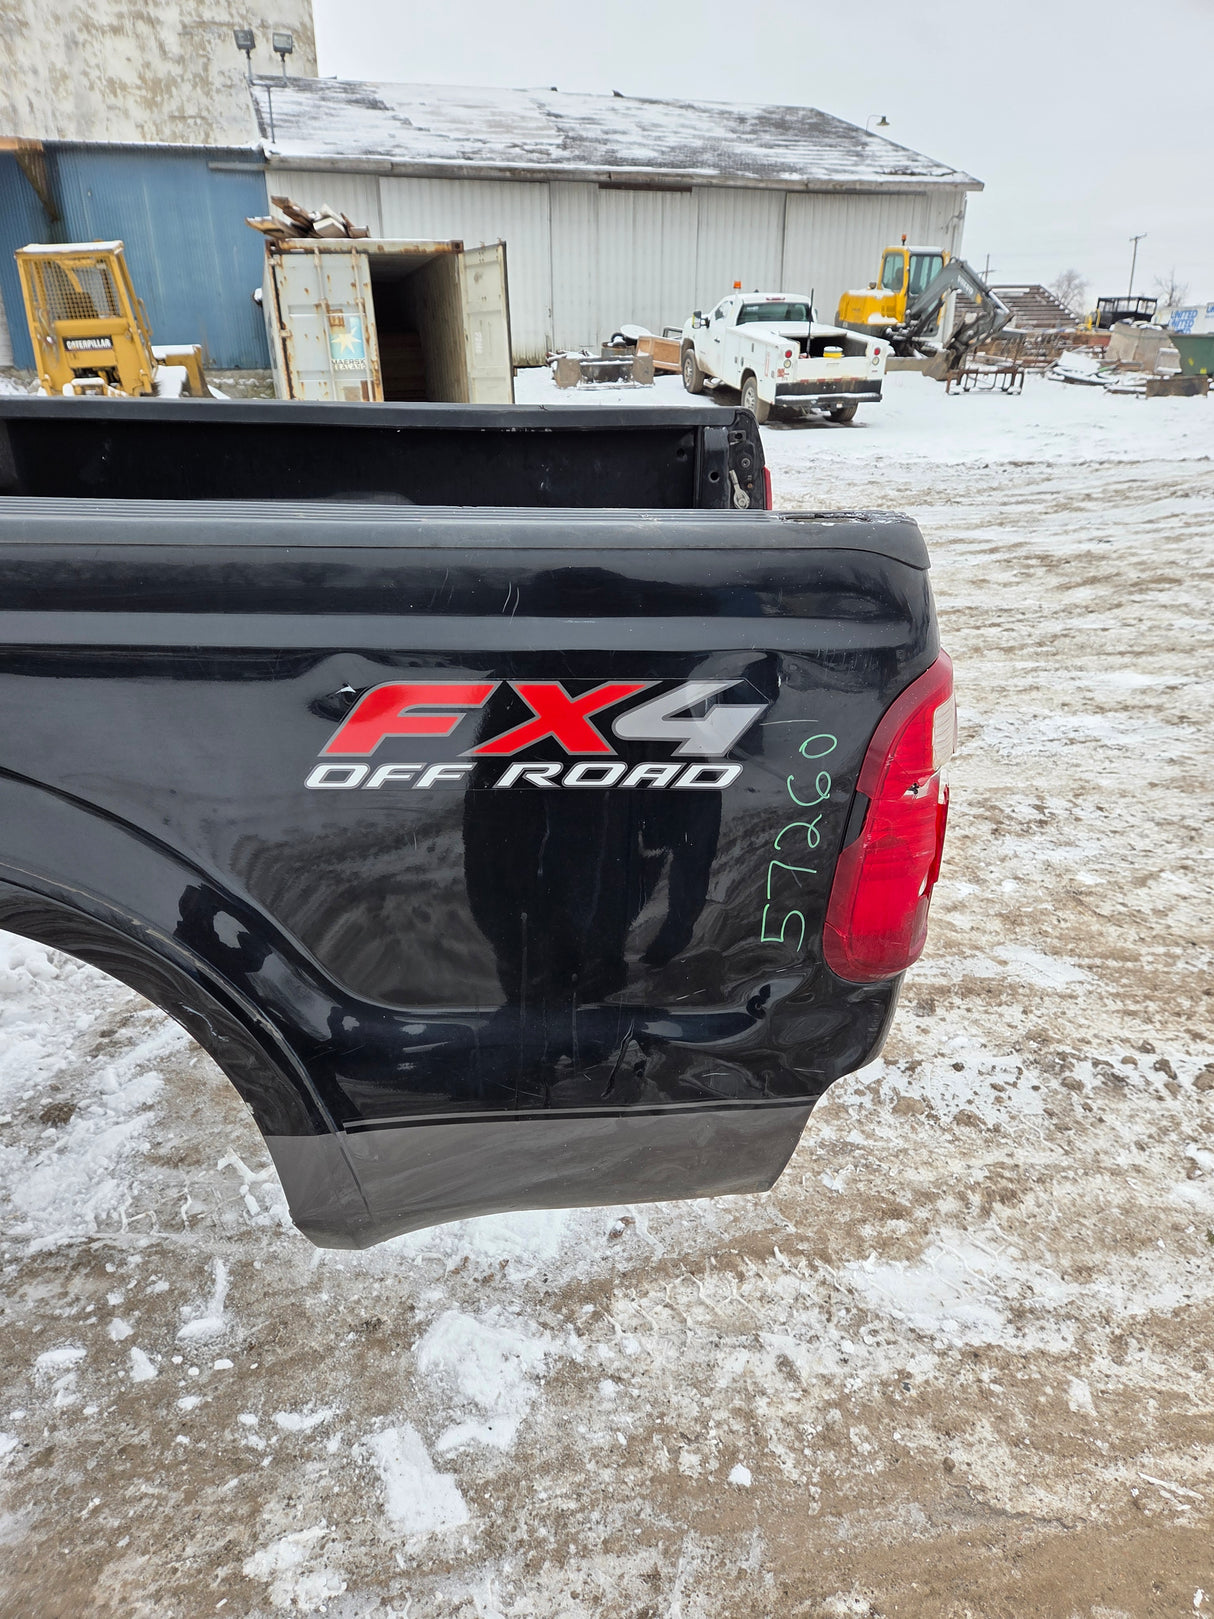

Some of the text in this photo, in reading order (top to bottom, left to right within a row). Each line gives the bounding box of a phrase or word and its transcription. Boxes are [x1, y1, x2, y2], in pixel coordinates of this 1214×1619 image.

[1171, 309, 1197, 319] UNITED
[66, 338, 112, 350] CATERPILLAR
[317, 680, 769, 757] FX4
[304, 761, 743, 790] OFF ROAD
[760, 733, 838, 953] 57260
